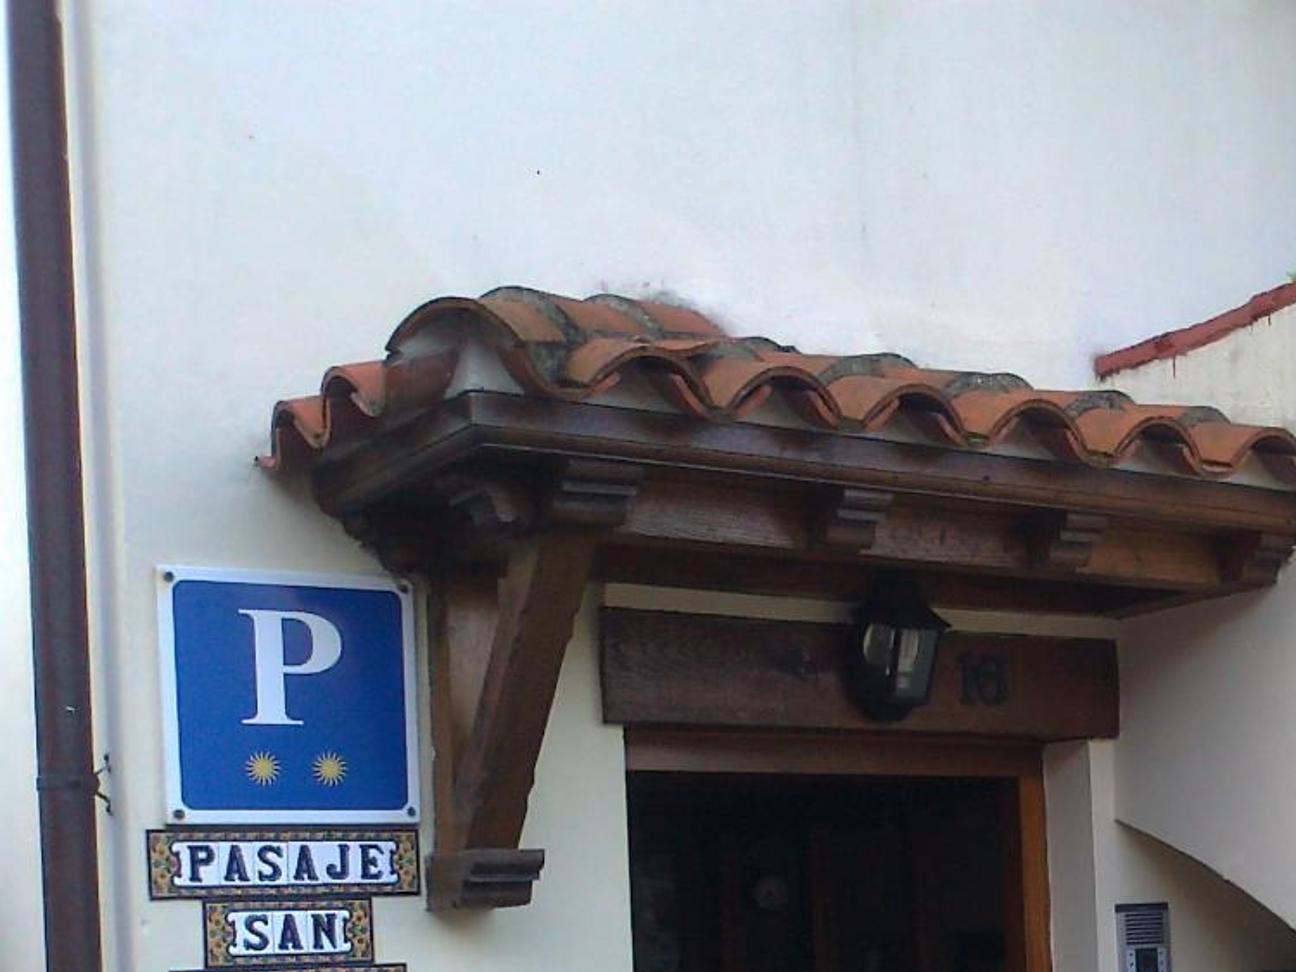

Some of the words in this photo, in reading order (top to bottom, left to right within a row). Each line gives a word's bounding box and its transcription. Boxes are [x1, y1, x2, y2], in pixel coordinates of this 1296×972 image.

[238, 608, 343, 725] P
[187, 843, 385, 884] PASAJE
[243, 913, 338, 952] SAN
